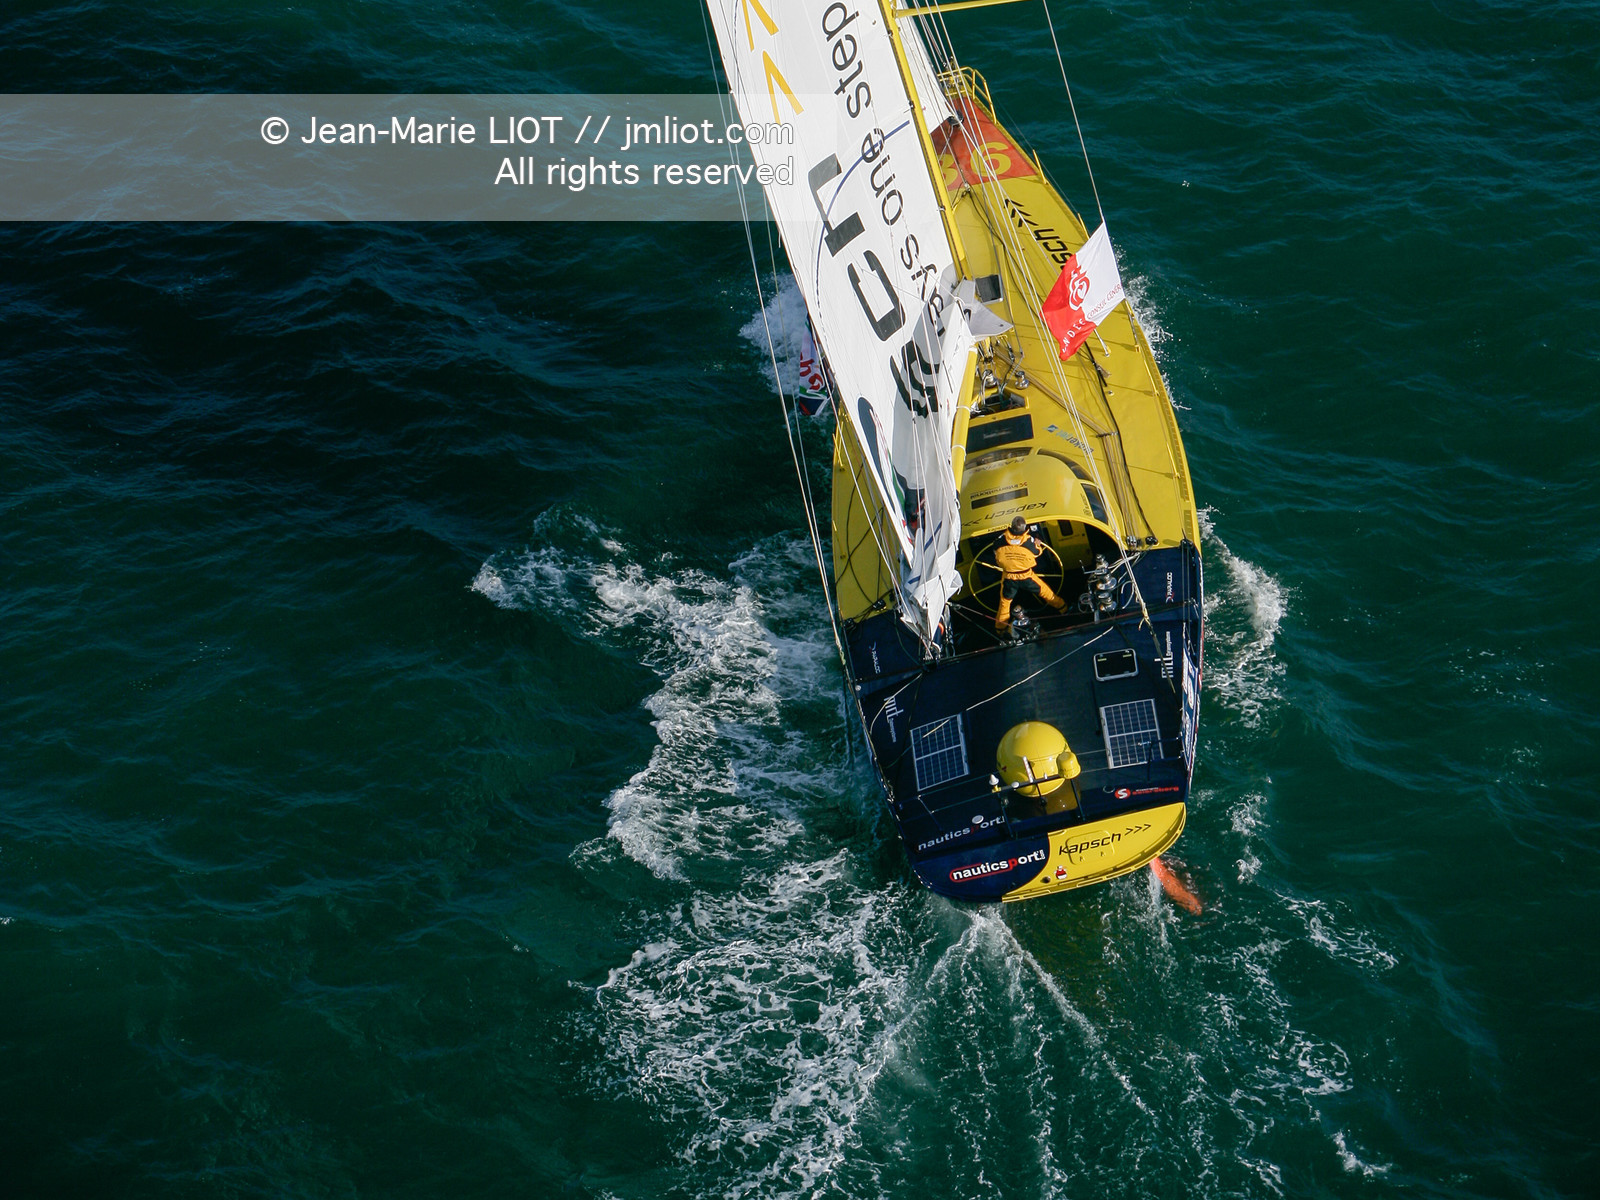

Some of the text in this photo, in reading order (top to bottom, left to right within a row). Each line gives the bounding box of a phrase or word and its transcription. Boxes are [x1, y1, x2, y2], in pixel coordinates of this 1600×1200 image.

[821, 2, 872, 118] step
[862, 127, 904, 226] one
[984, 501, 1048, 520] kapsch
[1058, 832, 1122, 856] kapsch
